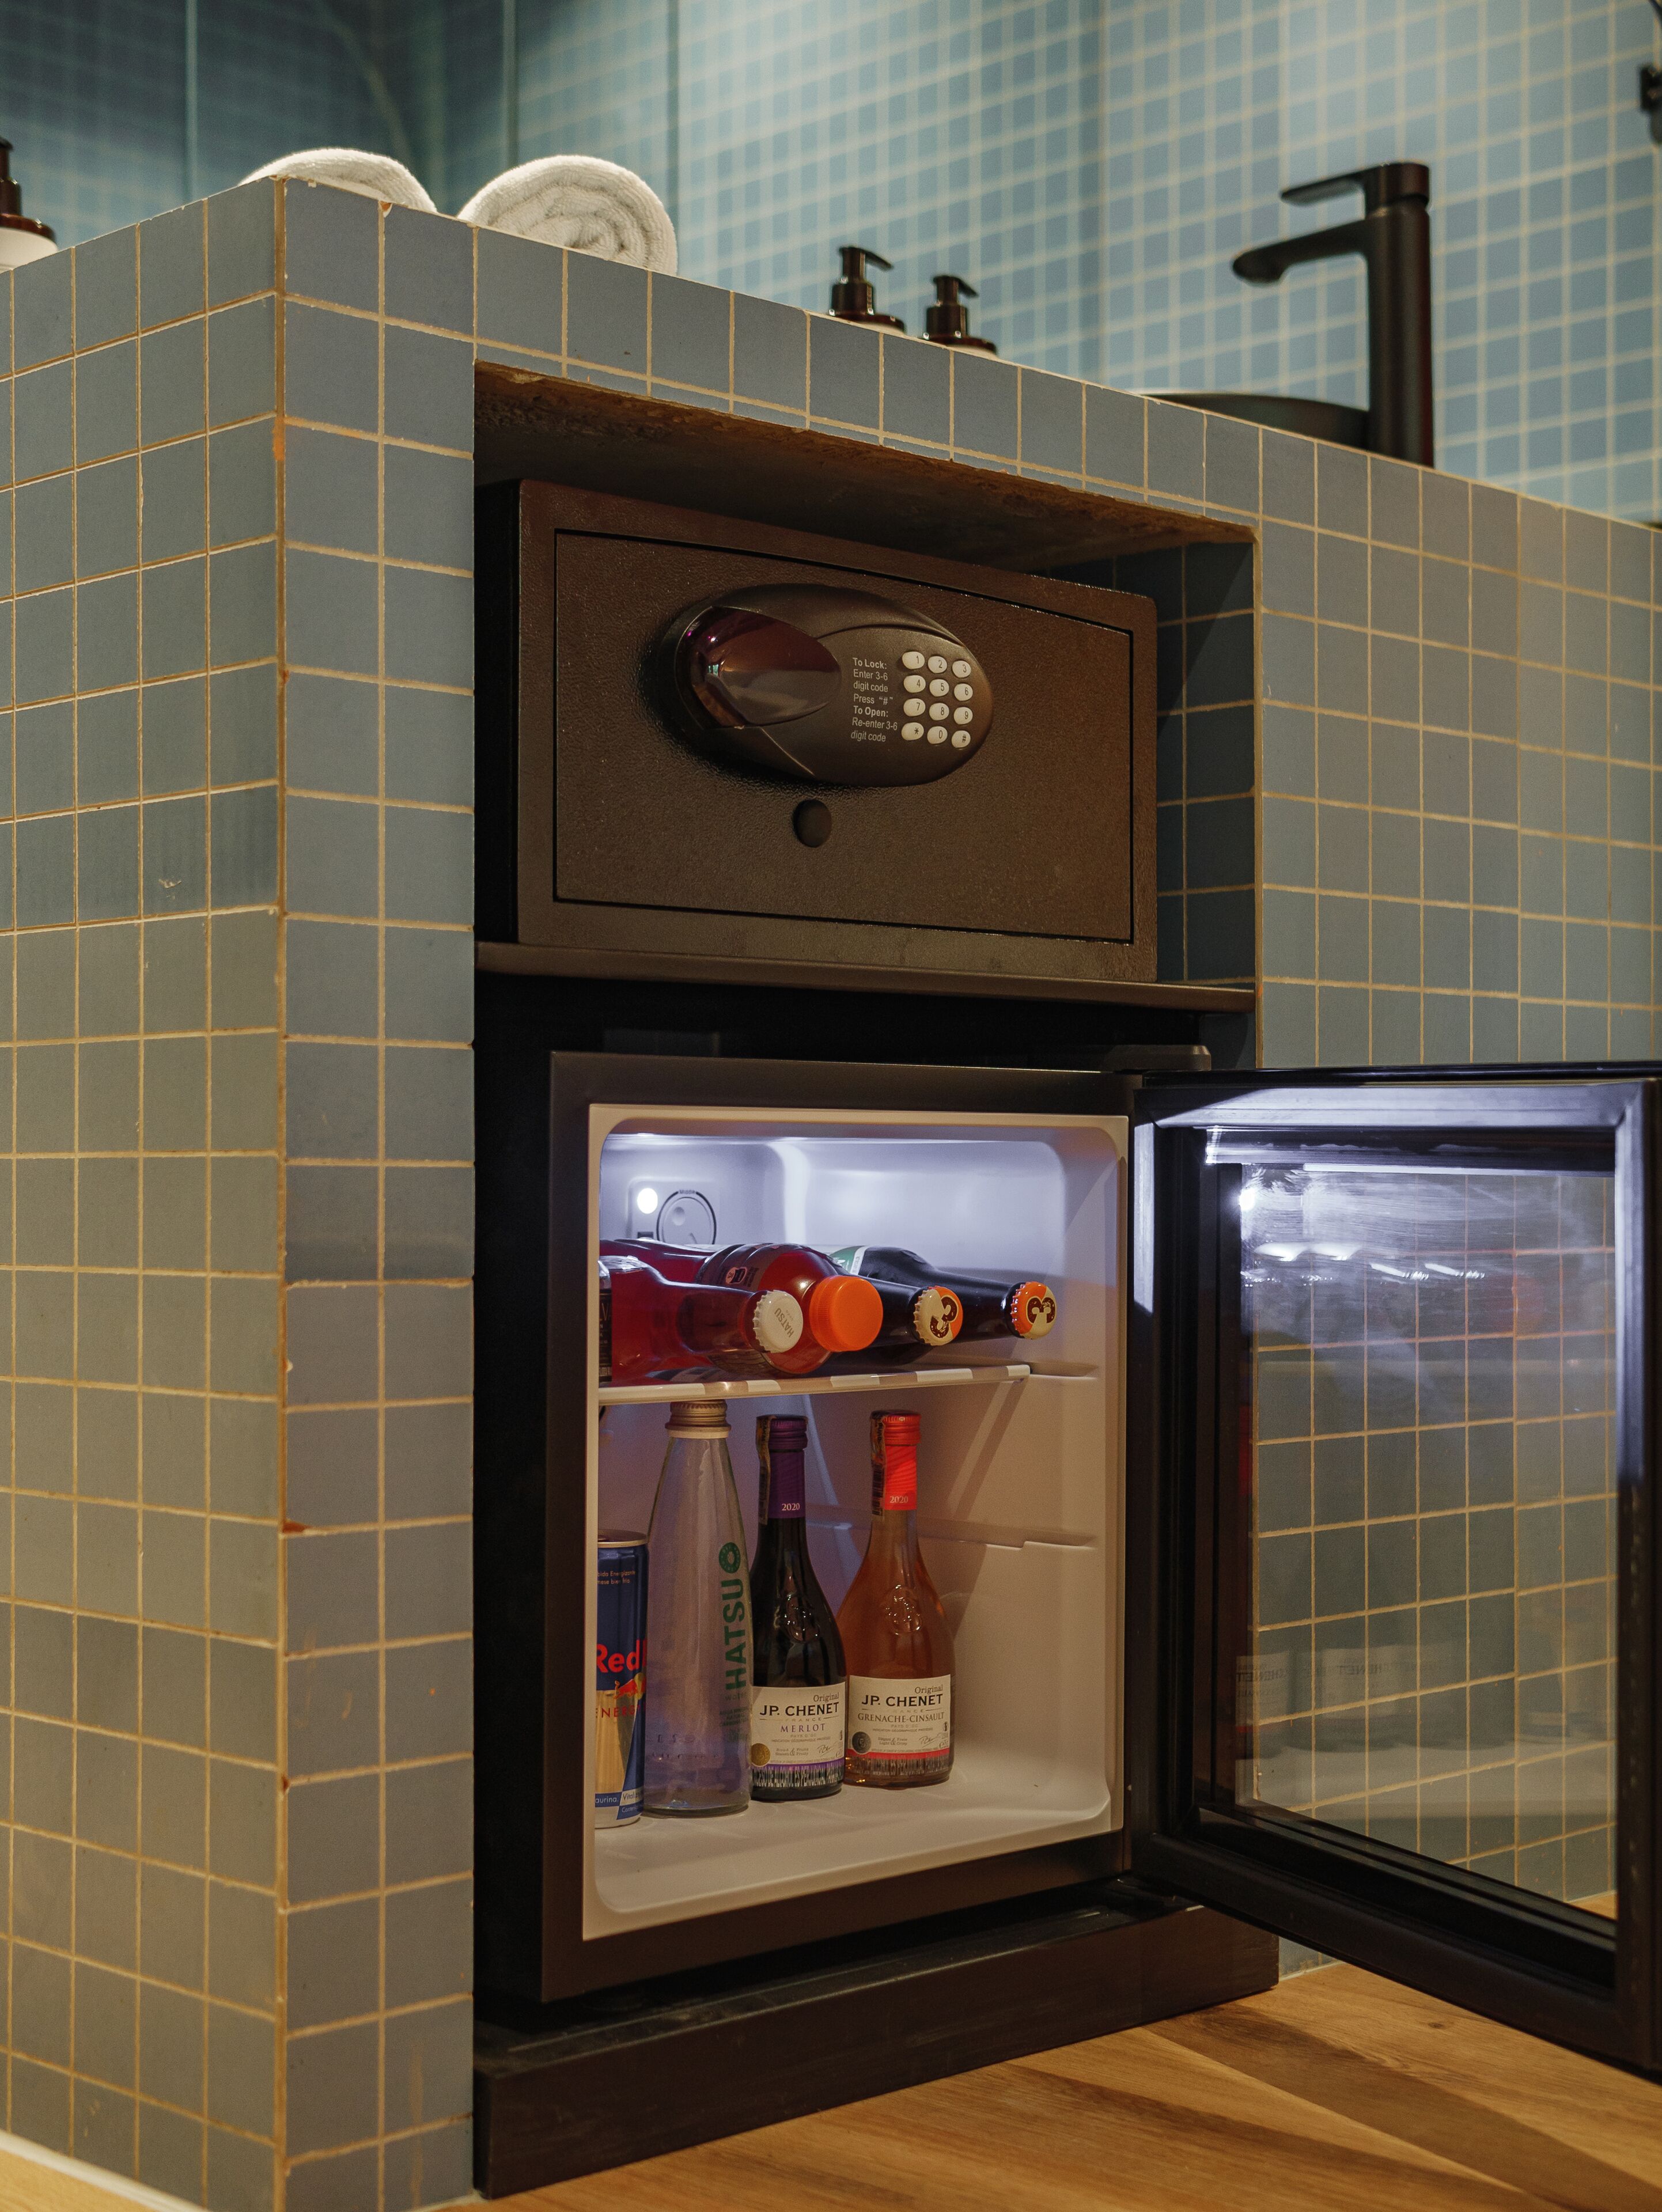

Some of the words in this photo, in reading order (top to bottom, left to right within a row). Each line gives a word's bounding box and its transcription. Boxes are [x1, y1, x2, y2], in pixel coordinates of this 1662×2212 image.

[853, 657, 863, 666] To
[865, 658, 887, 670] Lock:
[915, 655, 919, 664] 1
[938, 660, 942, 669] 2
[963, 664, 967, 673] 3
[853, 668, 874, 679] Enter
[876, 671, 888, 681] 3-6
[853, 680, 869, 692] digit
[870, 682, 888, 692] code
[916, 679, 921, 688] 4
[940, 683, 945, 692] 5
[964, 687, 969, 696] 6
[853, 693, 874, 704] Press
[853, 706, 864, 715] To
[865, 706, 888, 718] Open:
[916, 702, 921, 711] 7
[940, 706, 945, 715] 8
[964, 711, 969, 720] 9
[852, 717, 884, 729] Re-enter
[886, 720, 898, 730] 3-6
[851, 729, 866, 741] digit
[868, 732, 886, 742] code
[938, 729, 943, 739] 0
[774, 1308, 794, 1338] HATSU
[889, 1495, 908, 1503] 2020
[781, 1502, 800, 1511] 2020
[721, 1579, 747, 1690] HATSU
[596, 1639, 640, 1673] Red
[915, 1684, 943, 1695] Original
[813, 1692, 839, 1702] Original
[886, 1694, 943, 1707] CHENET
[596, 1703, 647, 1718] NERG
[785, 1702, 839, 1717] CHENET
[857, 1711, 945, 1723] GRENACHE-CINSAULT
[780, 1723, 826, 1733] MERLOT
